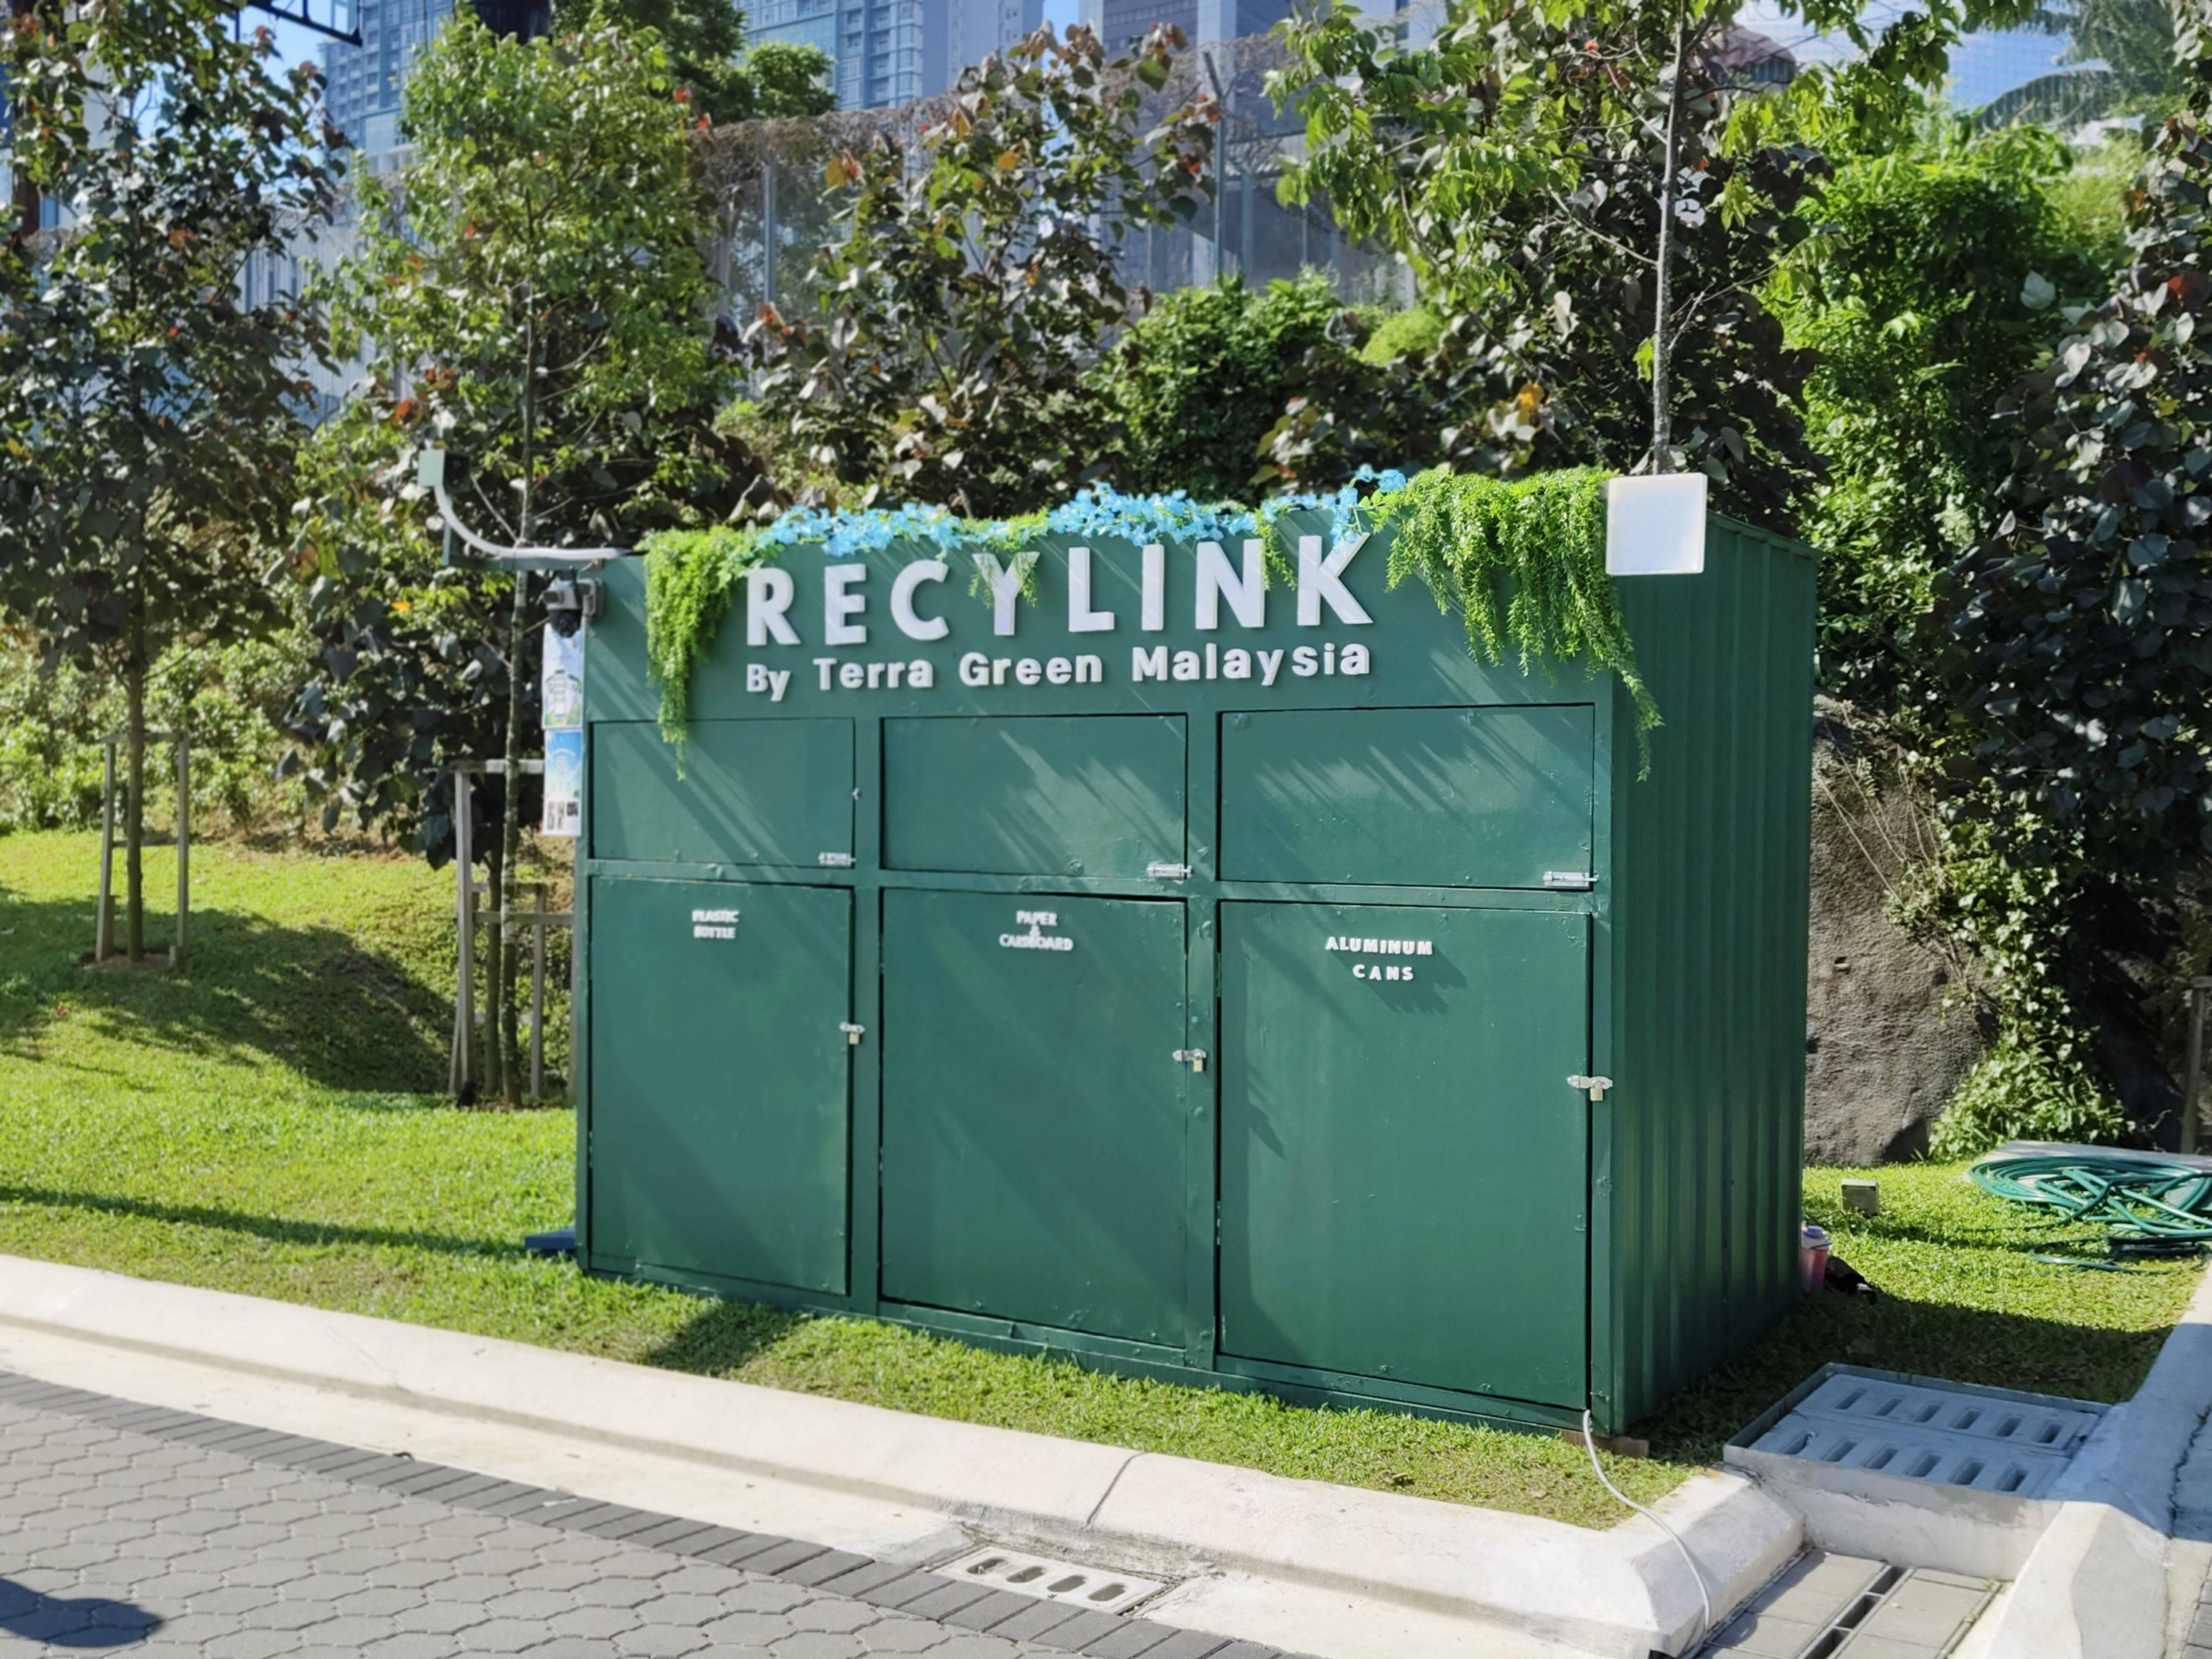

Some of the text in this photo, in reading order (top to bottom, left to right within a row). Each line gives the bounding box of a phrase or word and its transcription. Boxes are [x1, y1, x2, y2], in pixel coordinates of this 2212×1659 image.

[746, 532, 1373, 646] RECYLINK
[746, 643, 1370, 702] By Terra Green Malaysia
[692, 909, 740, 922] PLASTIC
[1016, 910, 1058, 926] PAPER
[693, 925, 736, 939] BOTTLE
[999, 933, 1074, 951] CARDBOARD
[1325, 936, 1433, 955] ALUMINUM
[1352, 964, 1414, 981] CANS
